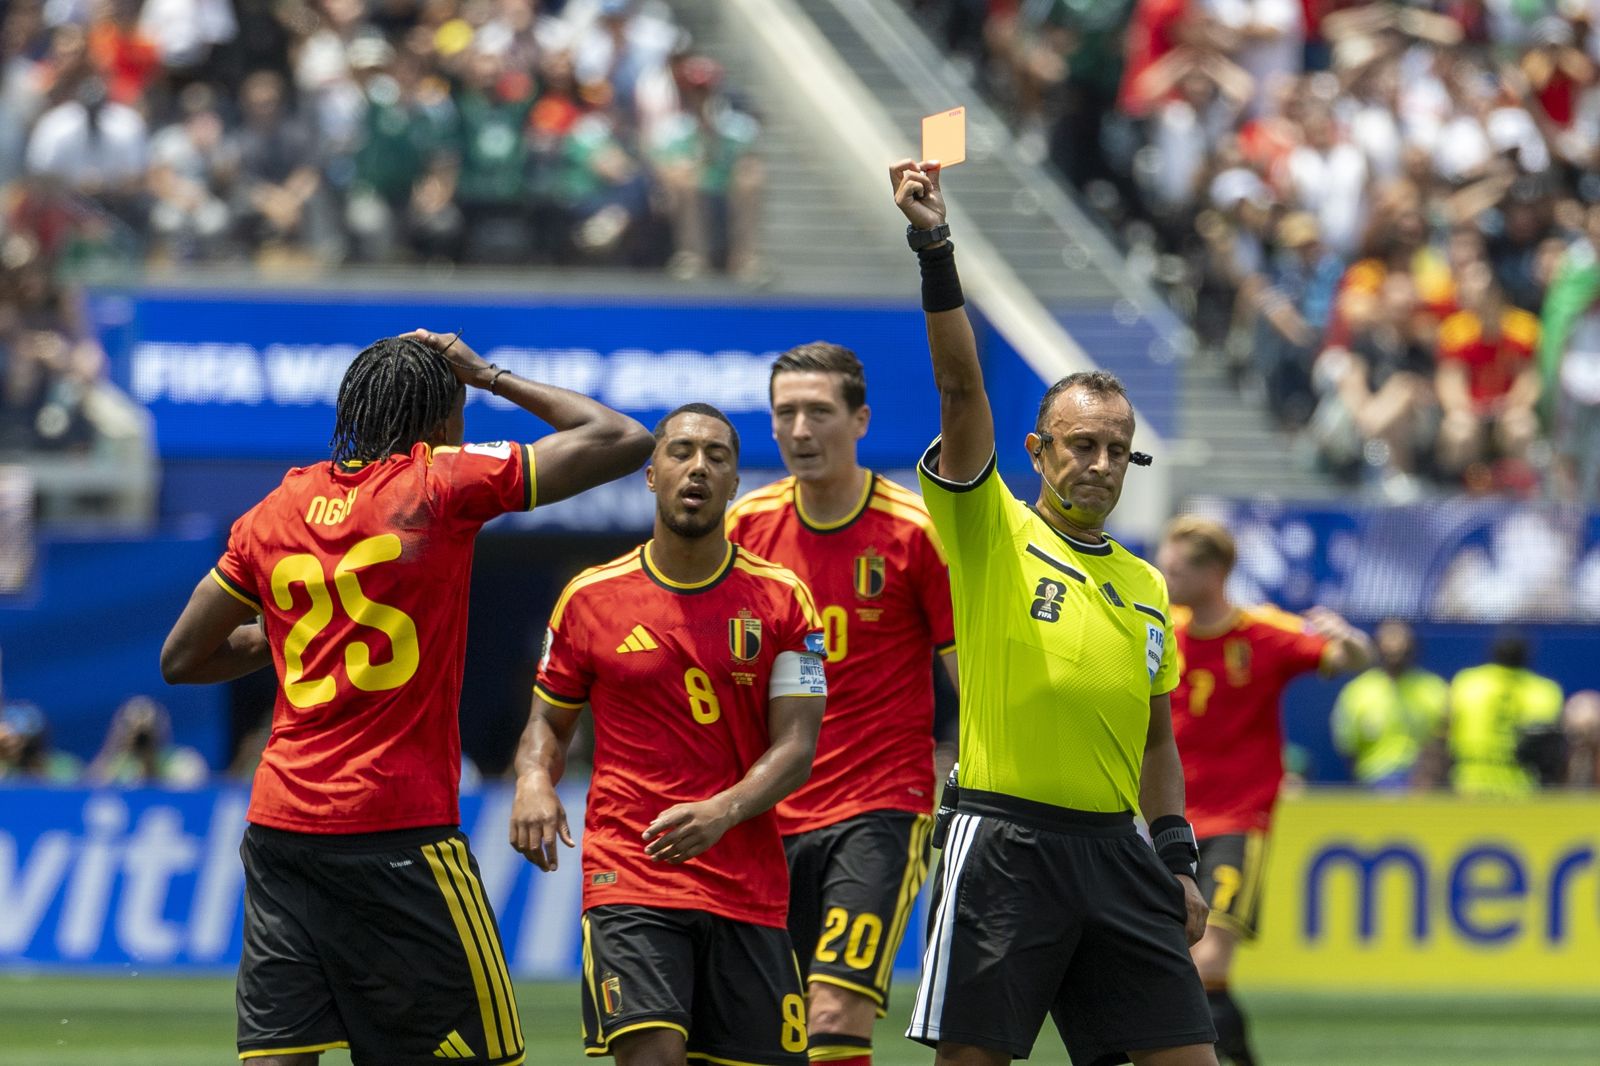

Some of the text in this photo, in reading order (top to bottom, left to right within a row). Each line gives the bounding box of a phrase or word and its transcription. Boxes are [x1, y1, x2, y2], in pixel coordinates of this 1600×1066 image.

[270, 533, 420, 708] 25
[821, 605, 848, 663] 0
[1037, 610, 1052, 620] FIFA
[684, 667, 720, 724] 8
[800, 665, 824, 677] UNITE
[1212, 864, 1241, 912] 7
[1303, 841, 1600, 944] mer
[815, 907, 883, 970] 20
[781, 993, 808, 1053] 8
